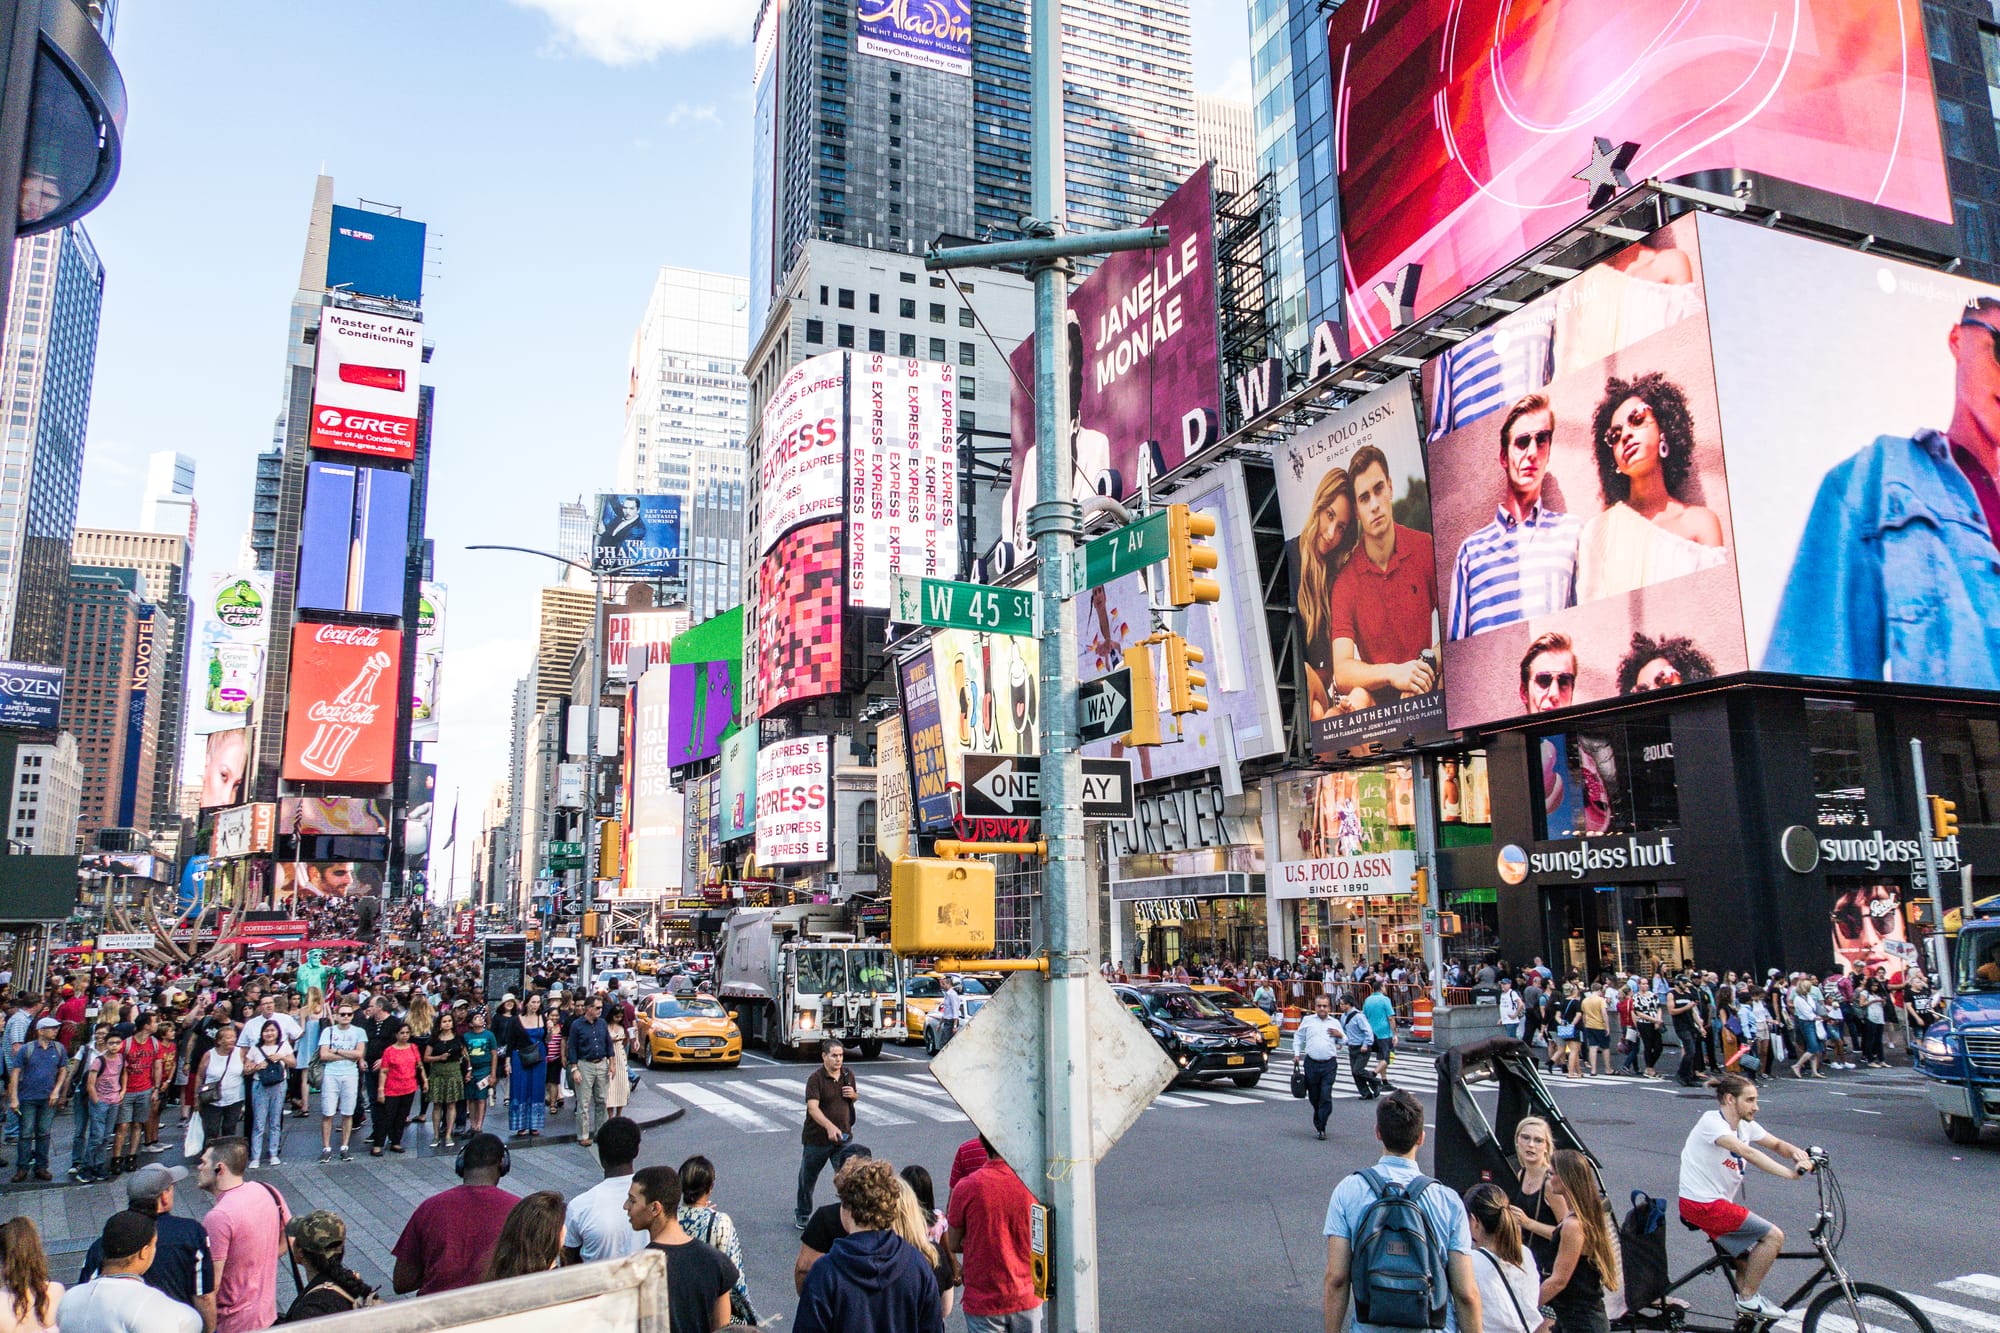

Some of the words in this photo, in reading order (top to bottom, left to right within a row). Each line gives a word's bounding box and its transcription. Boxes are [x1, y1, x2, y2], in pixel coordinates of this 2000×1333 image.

[863, 25, 877, 34] THE
[879, 28, 891, 37] HIT
[893, 32, 934, 48] BROADWAY
[935, 41, 966, 54] MUSICAL
[1096, 232, 1198, 351] JANELLE
[330, 315, 376, 330] Master
[380, 325, 393, 333] of
[396, 327, 416, 337] Air
[338, 327, 414, 347] Conditioning
[1097, 294, 1183, 393] MONÁE
[345, 416, 409, 436] GREE
[872, 381, 882, 446] EXPRESS
[908, 386, 919, 450] EXPRESS
[942, 390, 952, 453] EXPRESS
[317, 427, 343, 438] Master
[353, 432, 364, 441] Air
[366, 434, 411, 447] Conditioning
[1307, 439, 1327, 459] U.S.
[1328, 422, 1358, 449] POLO
[1361, 403, 1395, 432] ASSN.
[333, 439, 396, 453] www.gree.com
[763, 418, 837, 490] EXPRESS
[1326, 446, 1349, 462] SINCE
[1352, 433, 1373, 449] 1890
[854, 448, 864, 514] EXPRESS
[872, 454, 882, 519] EXPRESS
[889, 452, 900, 518] EXPRESS
[908, 458, 919, 523] EXPRESS
[925, 456, 936, 521] EXPRESS
[942, 462, 953, 526] EXPRESS
[595, 547, 678, 559] PHANTOM
[853, 523, 864, 590] EXPRESS
[889, 526, 900, 573] EXPRE
[925, 530, 936, 576] EXPRE
[1109, 537, 1119, 573] 7
[220, 603, 262, 615] Green
[224, 614, 262, 626] Giant
[928, 585, 954, 622] W
[968, 592, 1000, 627] 45
[1014, 596, 1030, 618] St
[315, 624, 383, 647] Coca-Cola
[610, 617, 672, 641] PRETTY
[131, 614, 155, 690] NOVOTEL
[610, 641, 671, 665] WAN
[25, 705, 52, 713] THEATRE
[308, 700, 380, 724] Coca-Cola
[1088, 692, 1116, 722] WAY
[1323, 720, 1344, 732] LIVE
[1349, 695, 1439, 726] AUTHENTICALLY
[1340, 727, 1363, 736] FLANAGAN
[1421, 709, 1443, 718] PLAYERS
[771, 743, 809, 760] EXPRESS
[912, 723, 942, 753] COME
[881, 748, 893, 763] BEST
[914, 748, 945, 776] FROM
[776, 763, 821, 778] EXPRESS
[882, 771, 906, 799] HARRY
[918, 770, 946, 799] AWAY
[757, 784, 825, 819] EXPRESS
[992, 774, 1040, 799] ONE
[1083, 777, 1111, 800] AY
[881, 793, 909, 821] POTTER
[1110, 785, 1231, 857] FOREVER
[689, 790, 698, 872] PALACE
[776, 821, 821, 836] EXPRESS
[551, 844, 559, 853] W
[562, 844, 573, 853] 45
[771, 842, 809, 857] EXPRESS
[1530, 841, 1627, 879] sunglass
[1629, 837, 1676, 867] hut
[1820, 830, 1920, 871] sunglass
[1285, 865, 1308, 882] U.S.
[1312, 862, 1349, 881] POLO
[1353, 858, 1392, 878] ASSN
[1310, 885, 1338, 894] SINCE
[1344, 883, 1368, 892] 1890
[461, 913, 473, 932] tkts
[1135, 899, 1184, 920] FOREVER
[1186, 898, 1200, 920] 21
